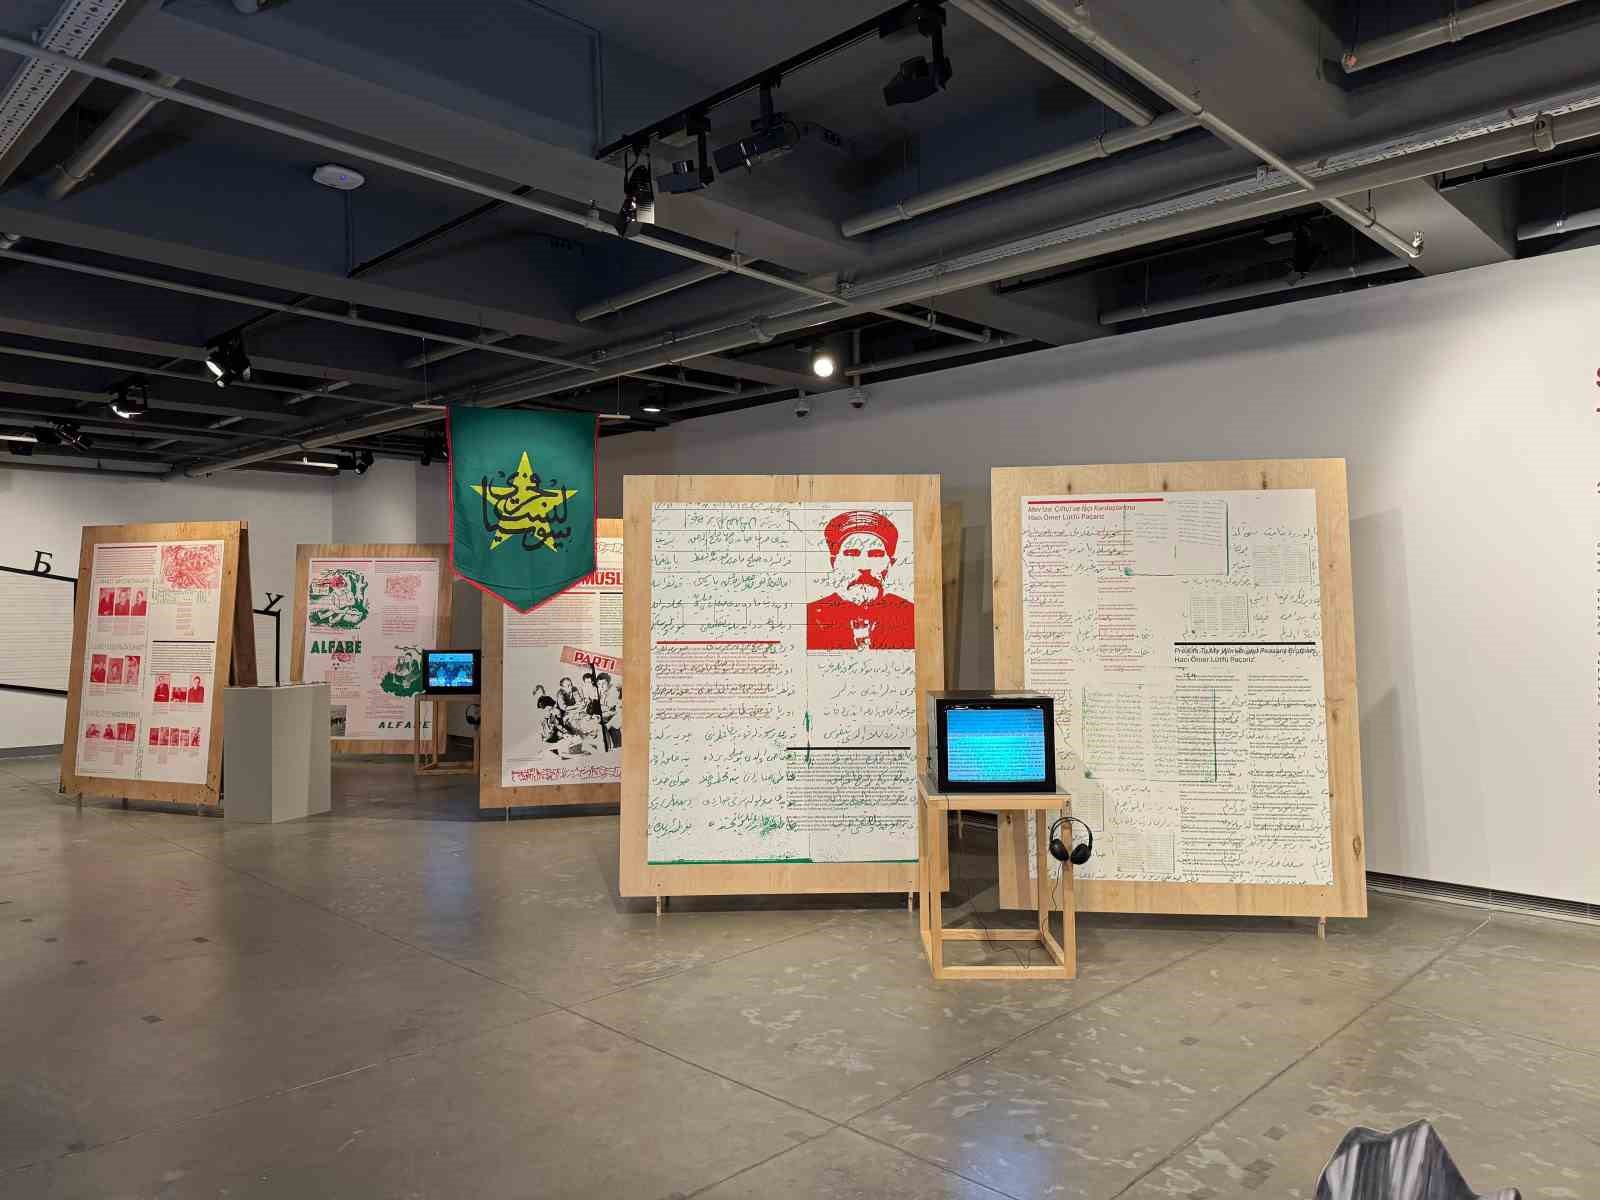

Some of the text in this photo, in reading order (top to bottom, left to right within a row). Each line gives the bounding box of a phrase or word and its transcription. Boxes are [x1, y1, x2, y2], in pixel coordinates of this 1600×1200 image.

[1043, 512, 1061, 521] Ömer
[34, 550, 53, 574] Б
[310, 640, 362, 654] ALFABE
[574, 652, 616, 670] PARTI
[377, 720, 432, 729] ALFAE
